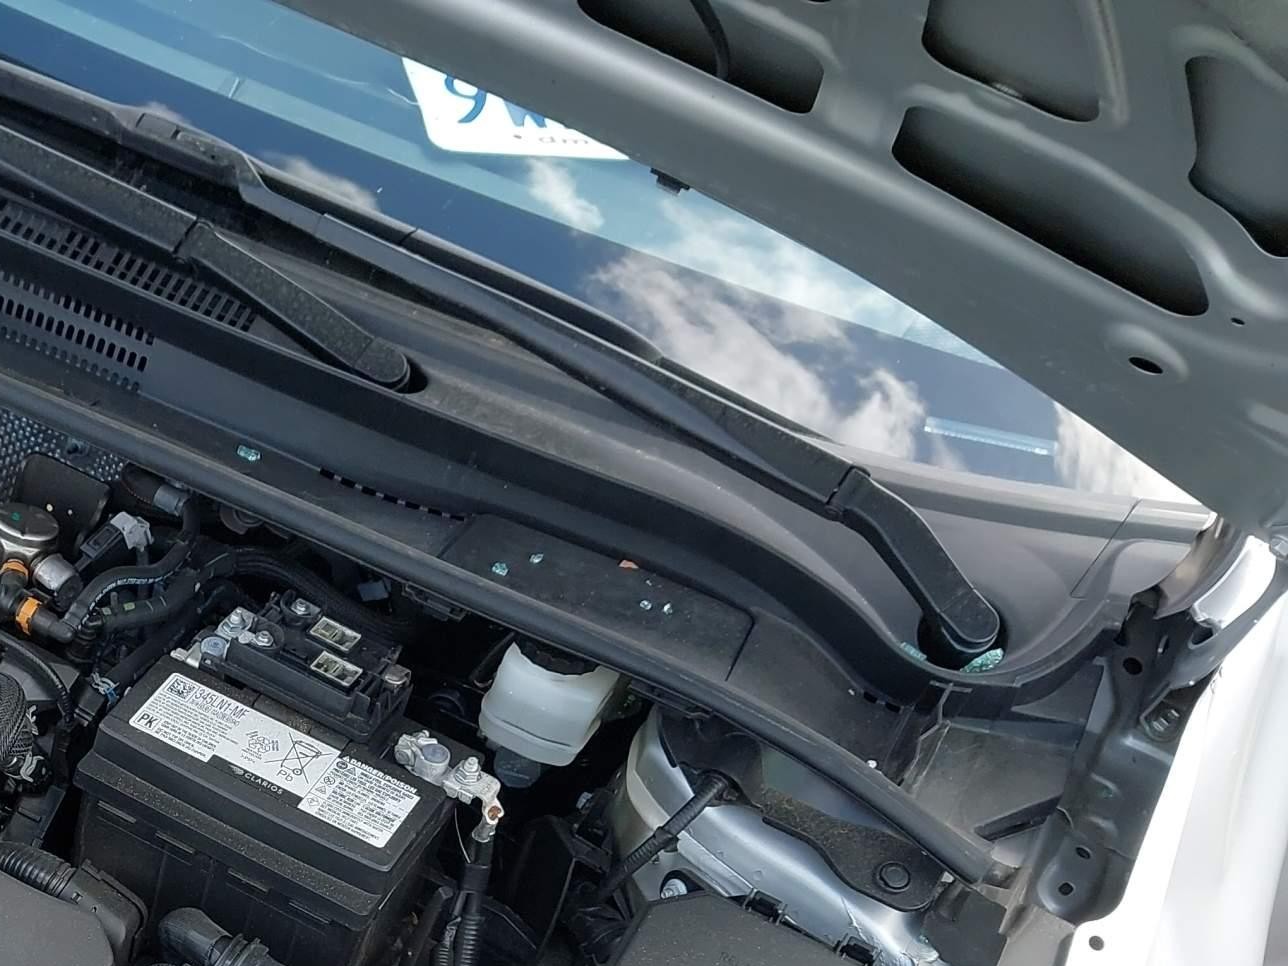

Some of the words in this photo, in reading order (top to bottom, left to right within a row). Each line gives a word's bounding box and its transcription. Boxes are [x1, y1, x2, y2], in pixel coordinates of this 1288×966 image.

[194, 688, 250, 719] 345LN1-MF
[137, 712, 159, 729] PK
[244, 772, 284, 795] CLARIOS
[277, 769, 294, 782] Pb
[349, 758, 418, 794] DANGER/POISON
